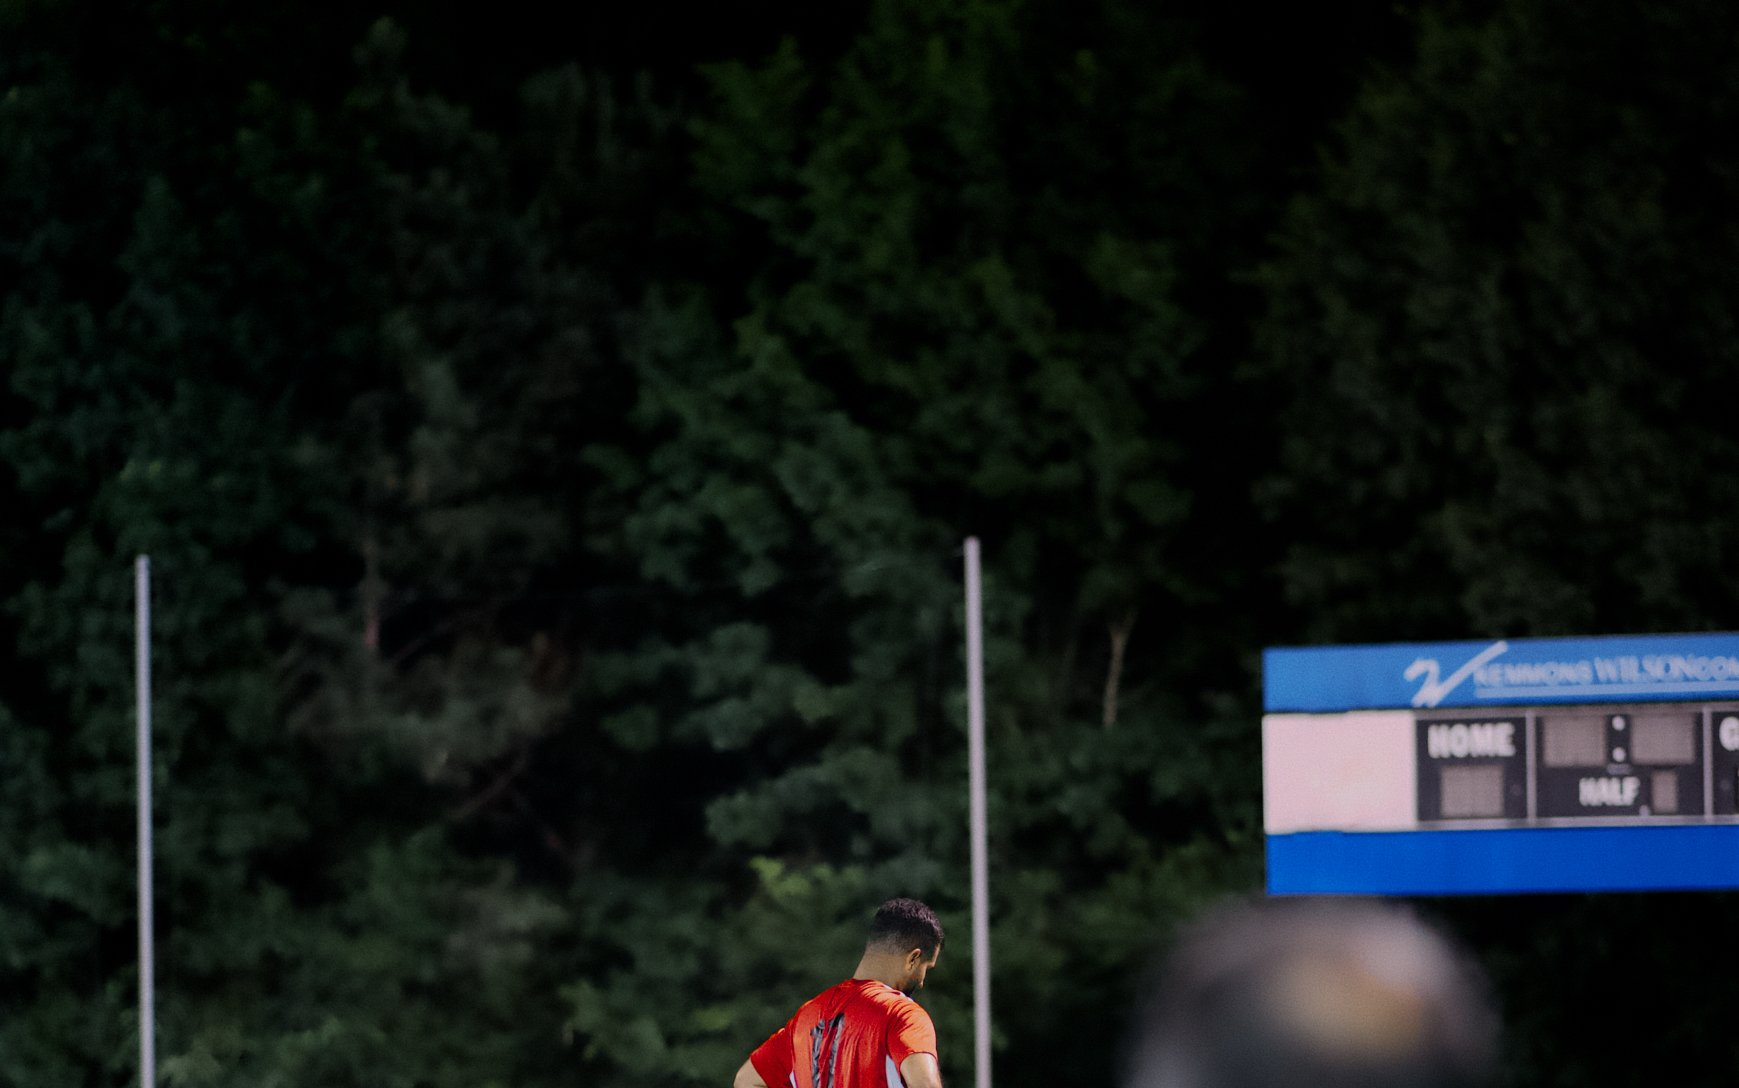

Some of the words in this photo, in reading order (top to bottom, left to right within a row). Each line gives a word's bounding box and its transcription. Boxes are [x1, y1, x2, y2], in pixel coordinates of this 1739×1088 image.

[1594, 654, 1696, 684] WILSON
[1428, 722, 1516, 759] HOME
[1578, 775, 1640, 807] HALF
